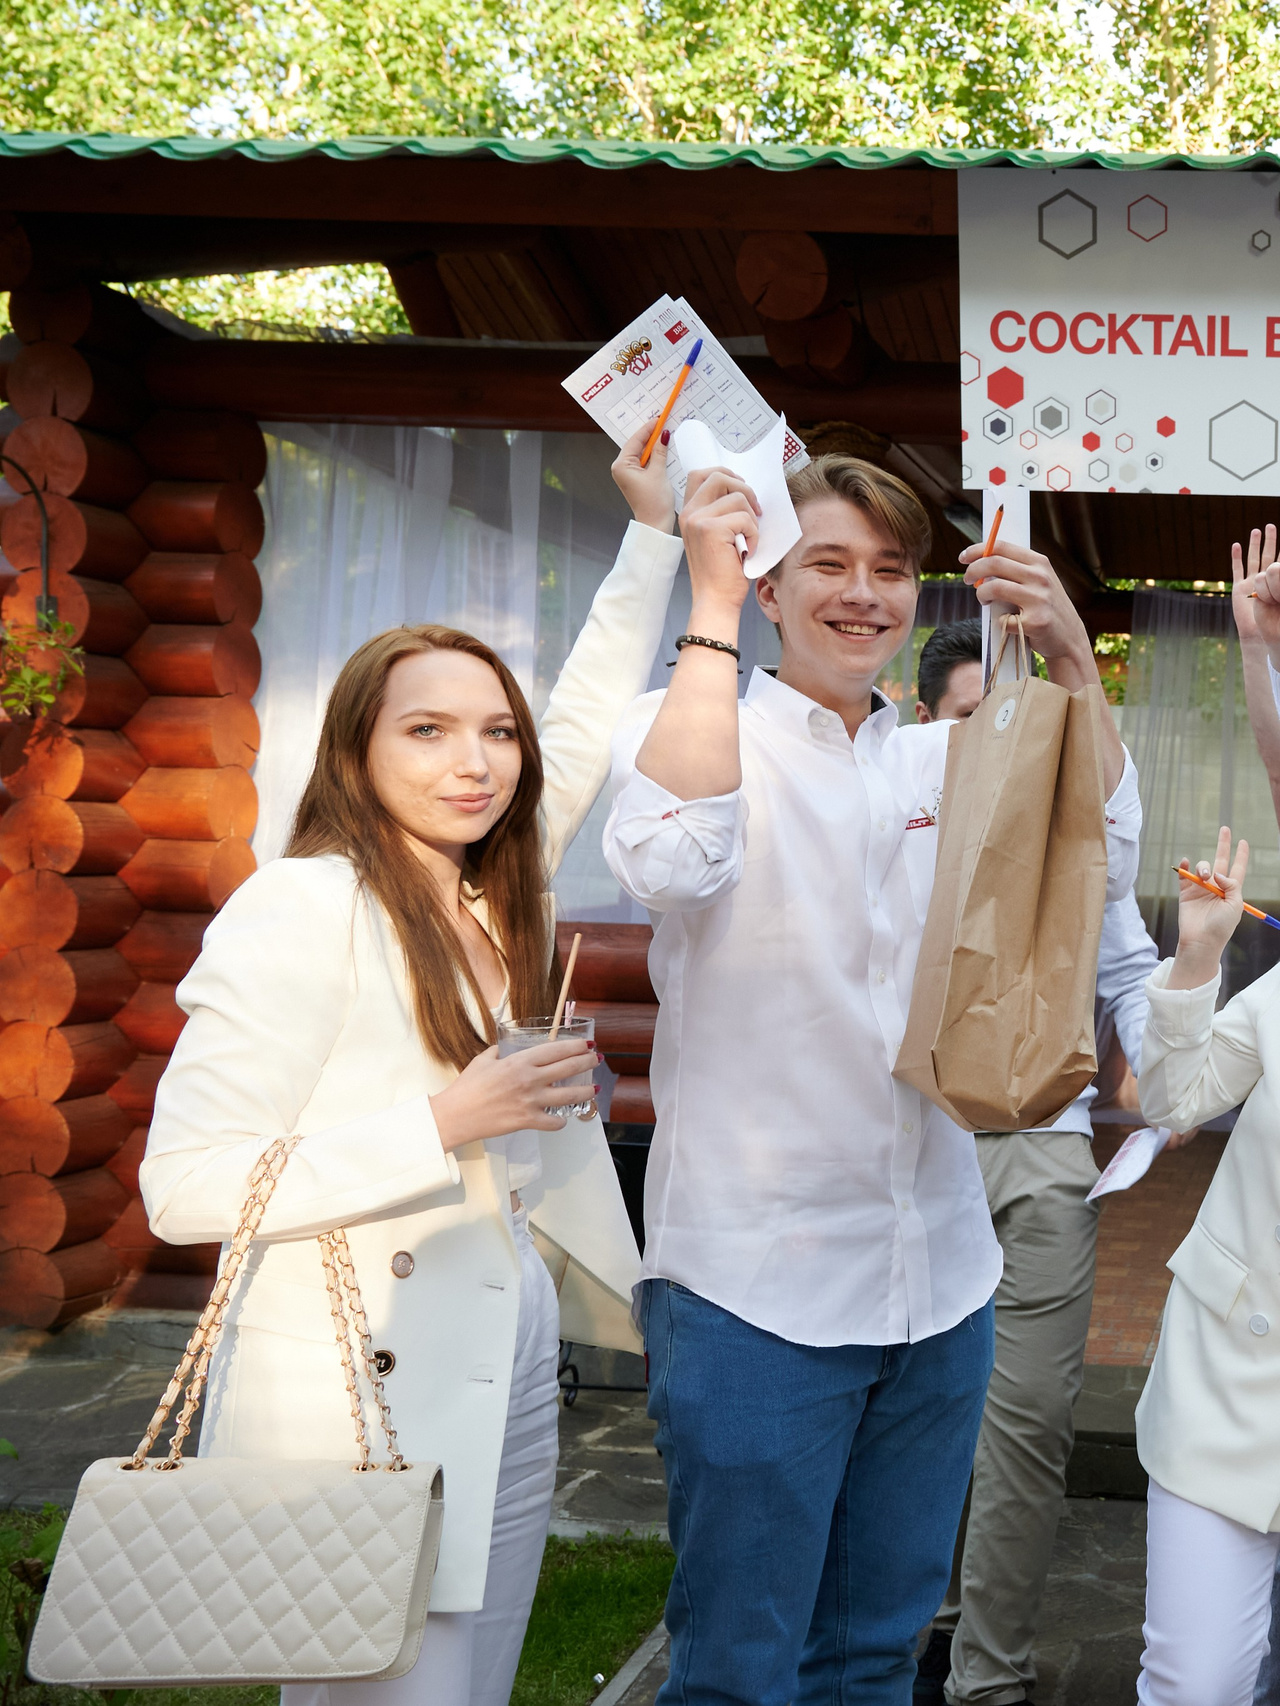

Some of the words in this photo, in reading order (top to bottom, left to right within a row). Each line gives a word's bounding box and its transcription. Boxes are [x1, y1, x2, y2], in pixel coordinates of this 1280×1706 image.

[990, 310, 1248, 357] COCKTAIL
[610, 336, 652, 376] BINGO
[582, 374, 612, 402] HILTI
[1002, 709, 1009, 722] 2
